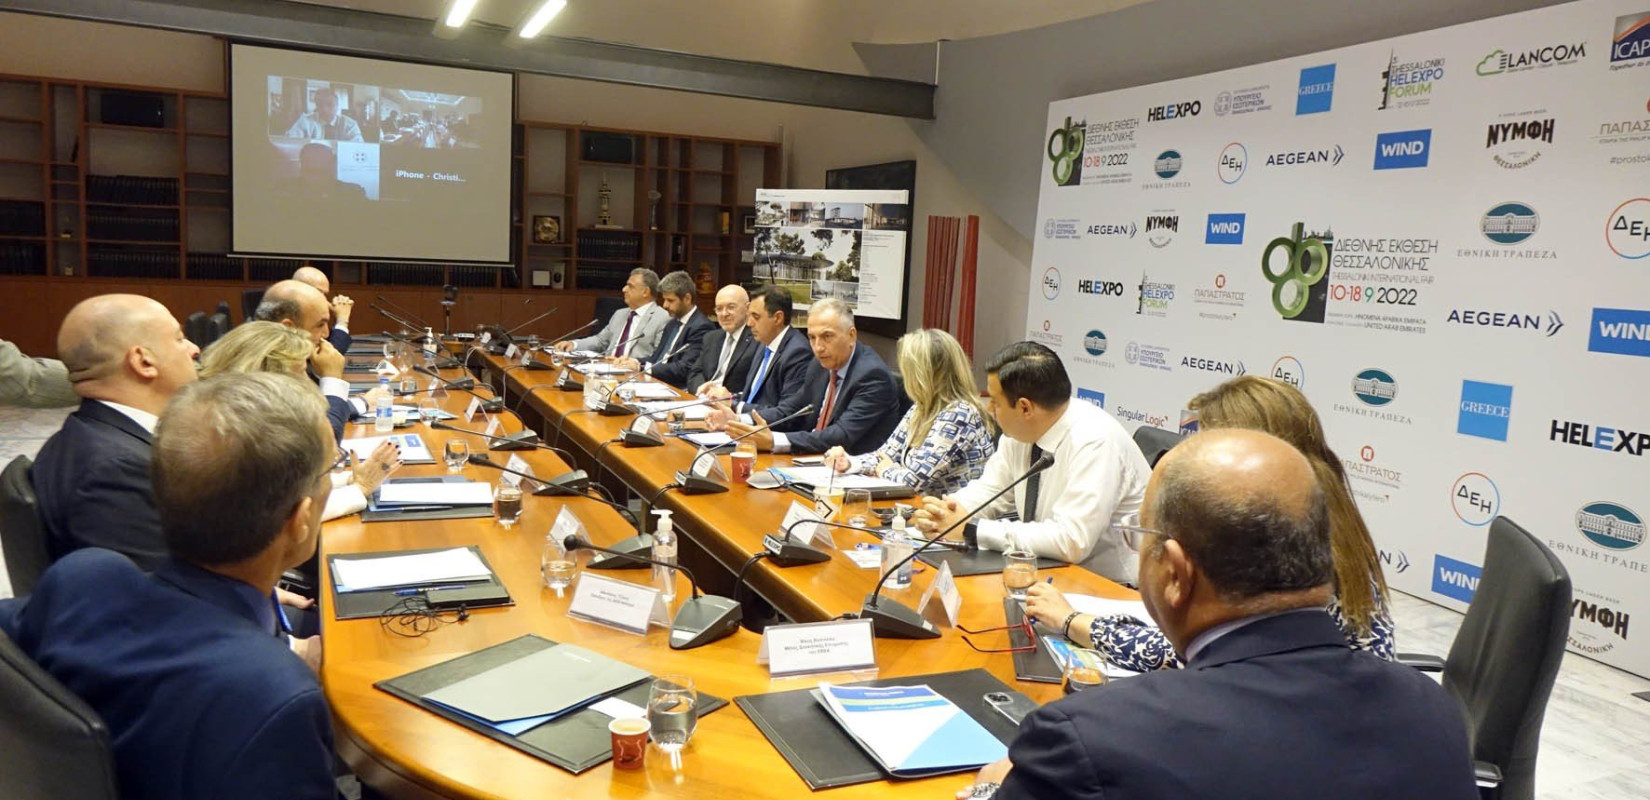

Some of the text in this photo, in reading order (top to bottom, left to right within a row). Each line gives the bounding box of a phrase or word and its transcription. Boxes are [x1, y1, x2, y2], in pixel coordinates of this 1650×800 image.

[1508, 43, 1586, 68] LANCOM
[1614, 39, 1650, 59] ICAP
[1390, 68, 1444, 86] HELEXPO
[1299, 82, 1333, 96] GREECE
[1390, 82, 1432, 98] FORUM
[1148, 100, 1201, 122] HELEXPO
[1600, 119, 1650, 135] ΠΑΠΑΣ
[1381, 140, 1424, 157] WIND
[1221, 154, 1243, 172] ΔΕΗ
[1266, 150, 1329, 166] AEGEAN
[396, 169, 424, 179] iPhone
[1087, 225, 1128, 235] AEGEAN
[1211, 222, 1240, 234] WIND
[1334, 239, 1438, 254] ΔΙΕΘΝΗΣ ΕΚΘΕΣΗ
[1457, 249, 1558, 259] ΕΘΝΙΚΗ ΤΡΑΠΕΖΑ
[1333, 254, 1430, 271] ΘΕΣΣΑΛΟΝΙΚΗΣ
[1078, 279, 1123, 296] HELEXPO
[1144, 289, 1175, 300] HELEXPO
[1377, 287, 1418, 306] 2022
[1447, 309, 1540, 329] AEGEAN
[1600, 321, 1650, 341] WIN
[1181, 356, 1233, 374] AEGEAN
[1461, 401, 1510, 418] GREECE
[1550, 419, 1650, 456] HELEXP
[1341, 459, 1402, 482] ΠΑΣΤΡΑΤΟΣ
[1457, 485, 1491, 513] ΔΕΗ
[1549, 540, 1648, 573] ΕΘΝΙΚΗ ΤΡΑΠΕ
[1571, 599, 1630, 641] ΥΜΦΗ
